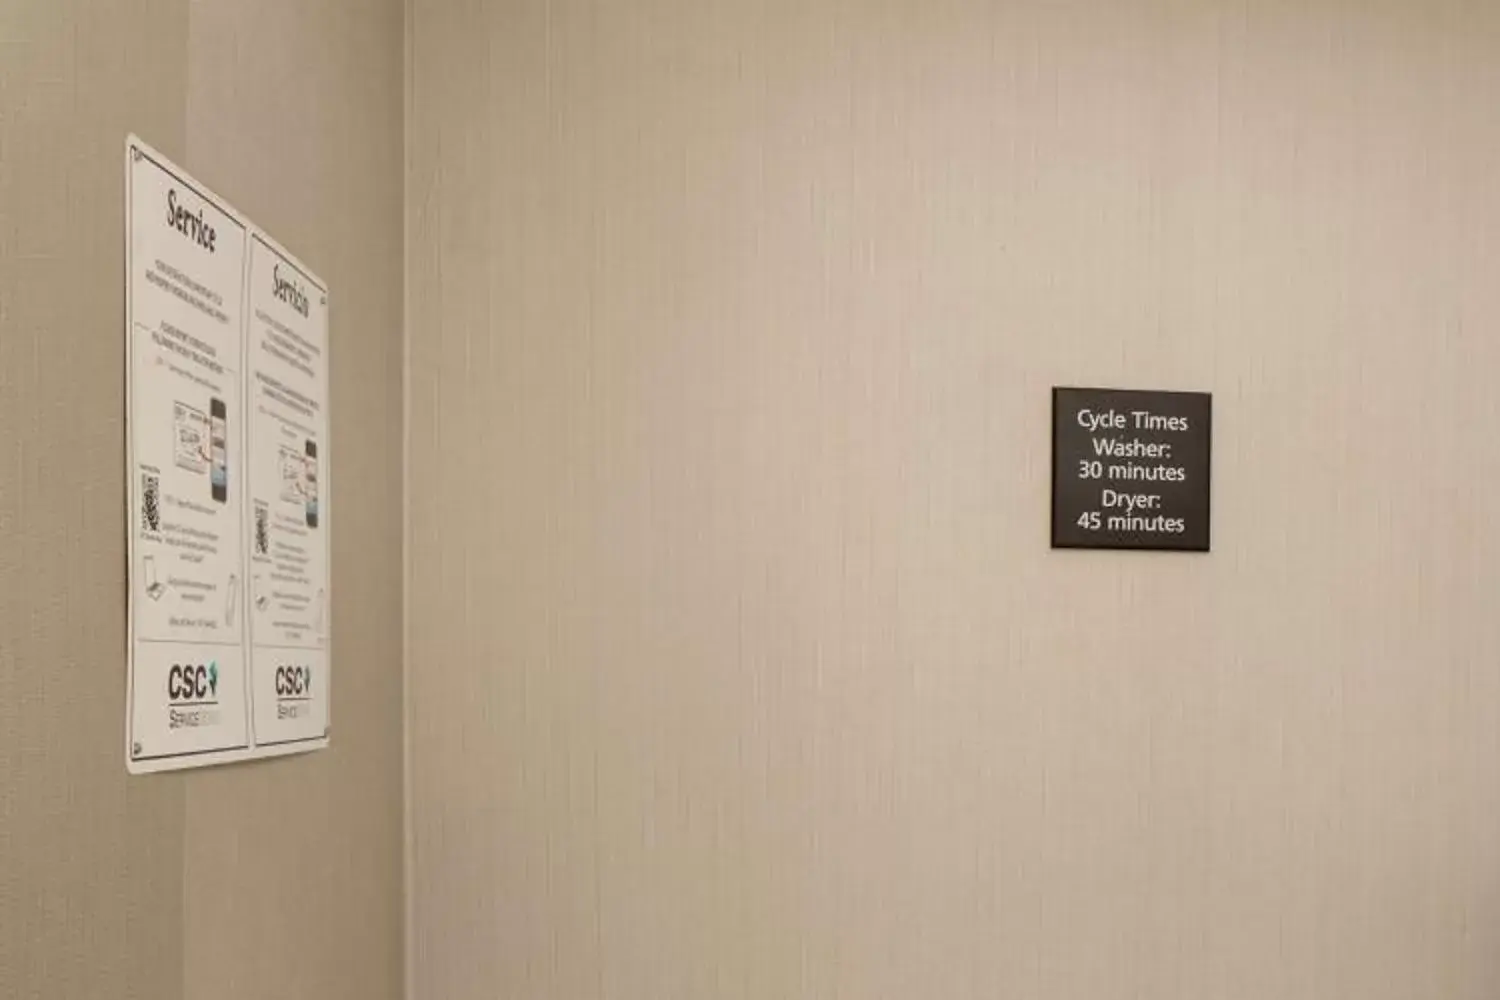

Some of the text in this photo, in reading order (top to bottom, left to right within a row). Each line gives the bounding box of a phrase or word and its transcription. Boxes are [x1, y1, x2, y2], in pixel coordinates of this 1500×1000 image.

[166, 189, 217, 253] Service
[272, 263, 310, 319] Servicio
[1077, 409, 1188, 431] Cycle Times
[1092, 438, 1171, 459] Washer:
[1078, 460, 1186, 481] 30 minutes
[1102, 489, 1161, 512] Dryer:
[1077, 512, 1186, 532] 45 minutes
[168, 664, 207, 700] CSC
[275, 665, 303, 695] CSC
